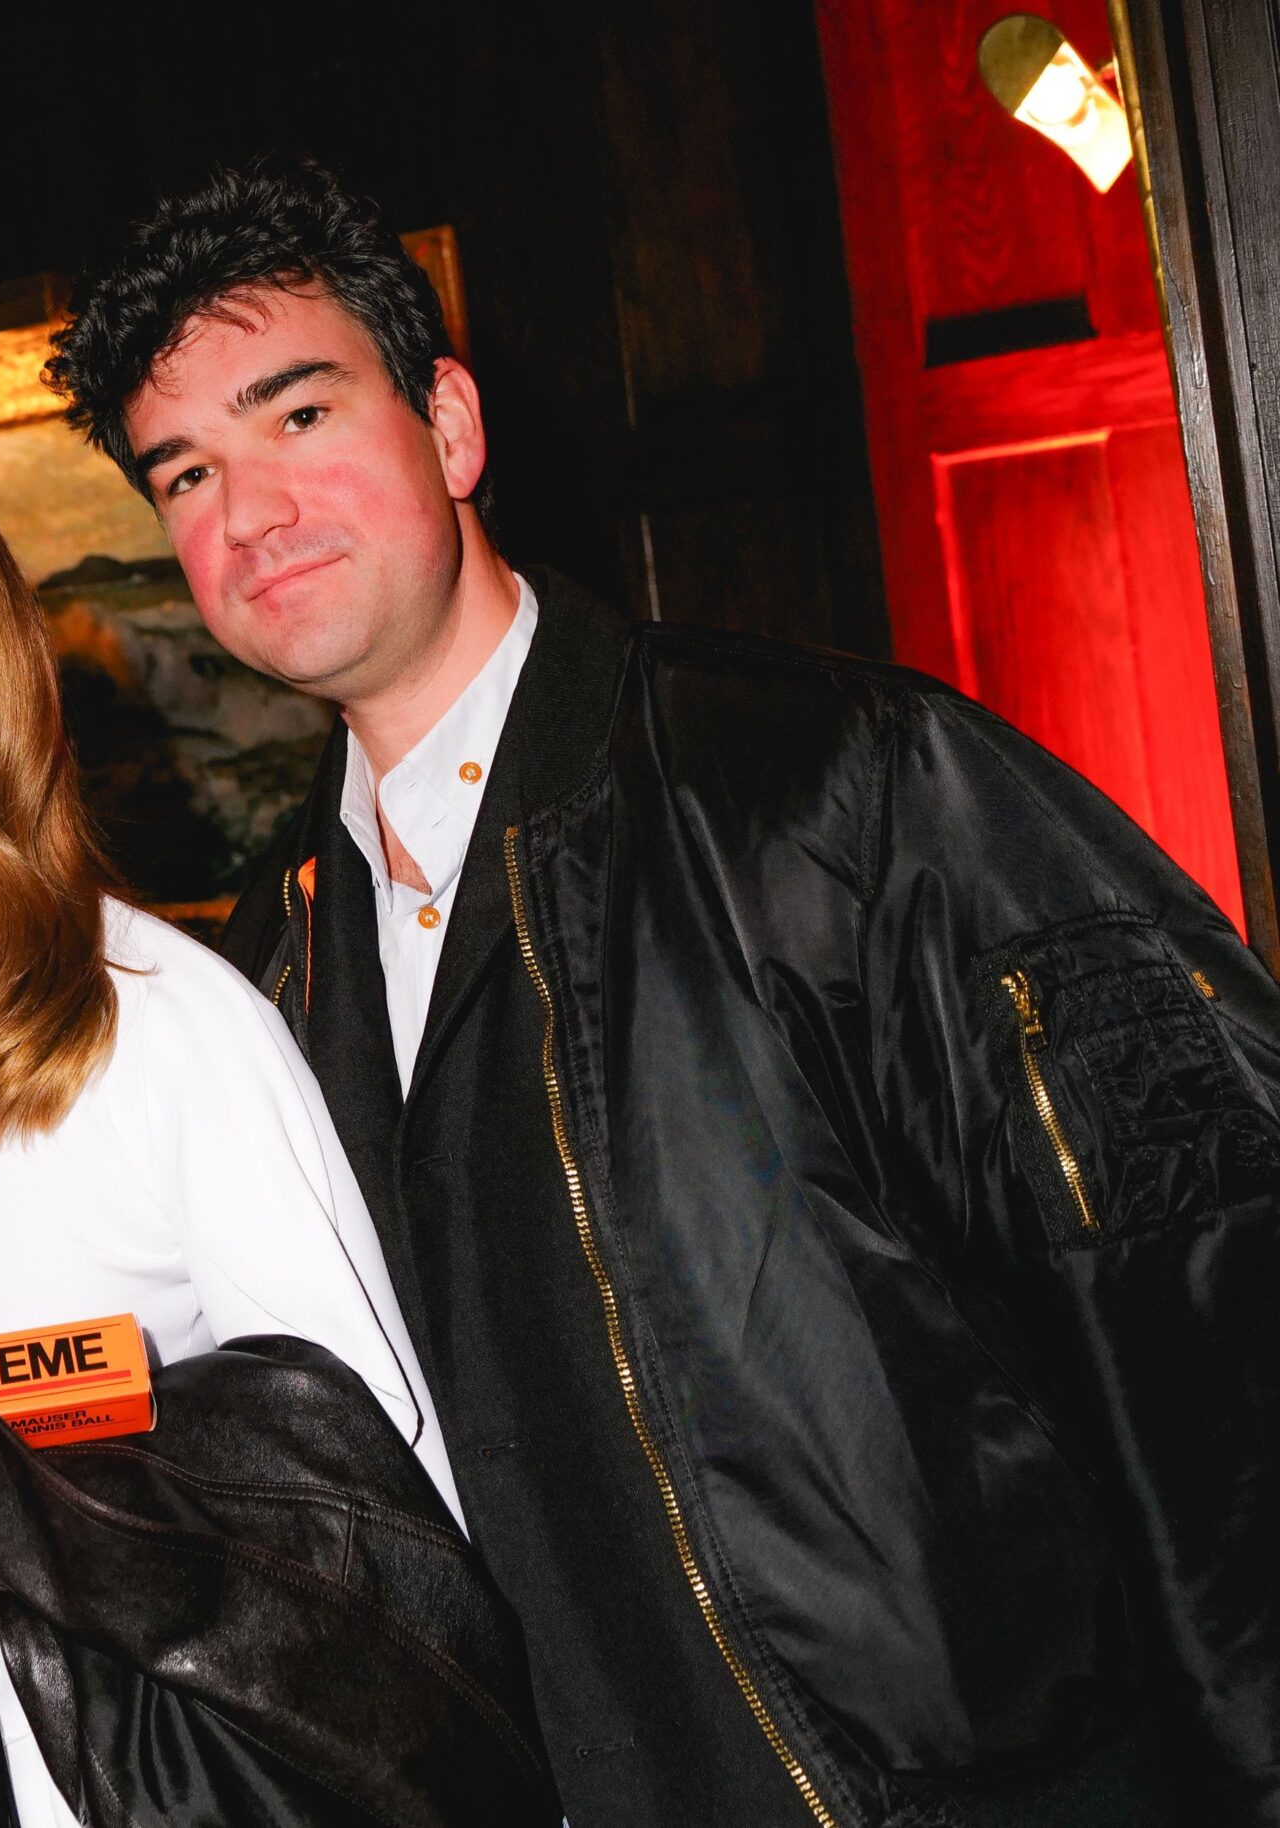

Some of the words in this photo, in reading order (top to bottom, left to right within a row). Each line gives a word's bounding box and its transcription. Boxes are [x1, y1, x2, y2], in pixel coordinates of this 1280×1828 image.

[11, 1410, 87, 1429] MAUSER
[13, 1422, 66, 1435] ENNIS
[71, 1414, 115, 1427] BALL
